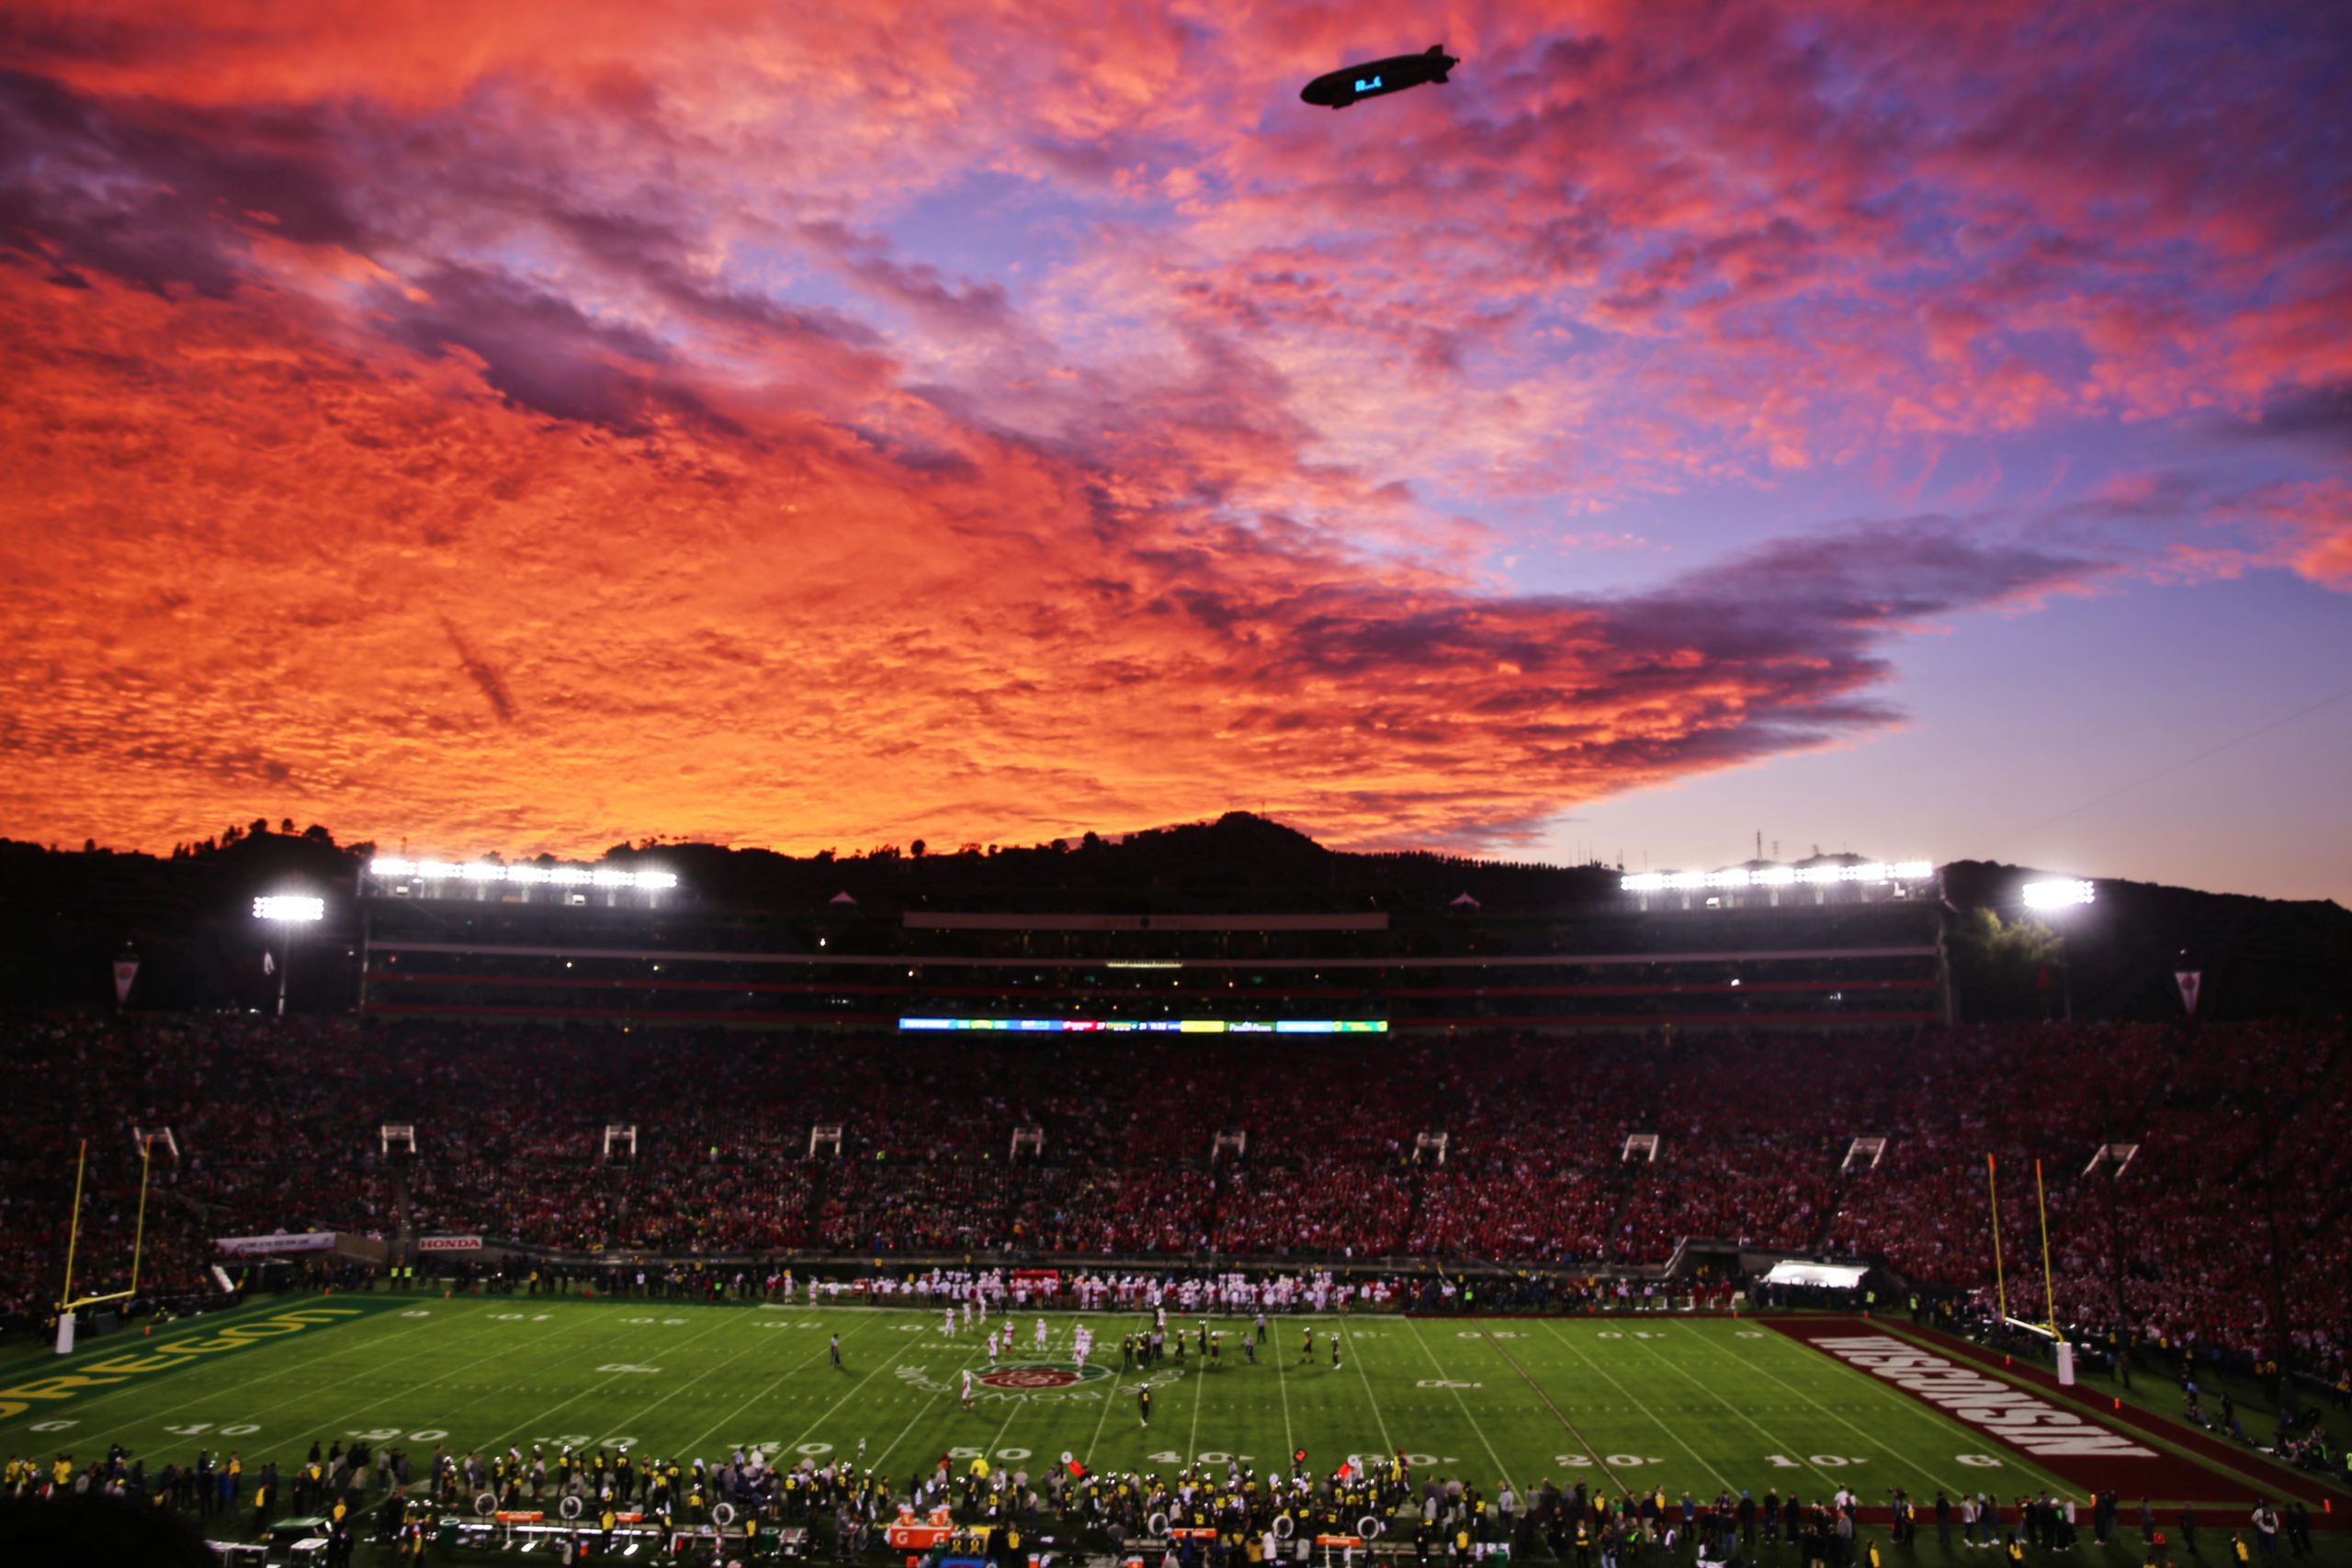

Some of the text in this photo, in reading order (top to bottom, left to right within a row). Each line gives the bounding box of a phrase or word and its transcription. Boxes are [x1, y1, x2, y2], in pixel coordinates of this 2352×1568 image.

[420, 1238, 481, 1250] HONDA
[1808, 1335, 2159, 1459] WISCONSIN
[28, 1420, 80, 1432] G
[175, 1423, 262, 1437] 10
[356, 1428, 449, 1442] 20
[548, 1435, 639, 1449] 30
[946, 1447, 1033, 1461] 50
[1147, 1451, 1240, 1464] 40
[1554, 1454, 1648, 1467] 20
[1765, 1454, 1856, 1468] 10
[1955, 1454, 2004, 1468] G
[896, 1531, 910, 1544] G
[933, 1532, 945, 1544] G
